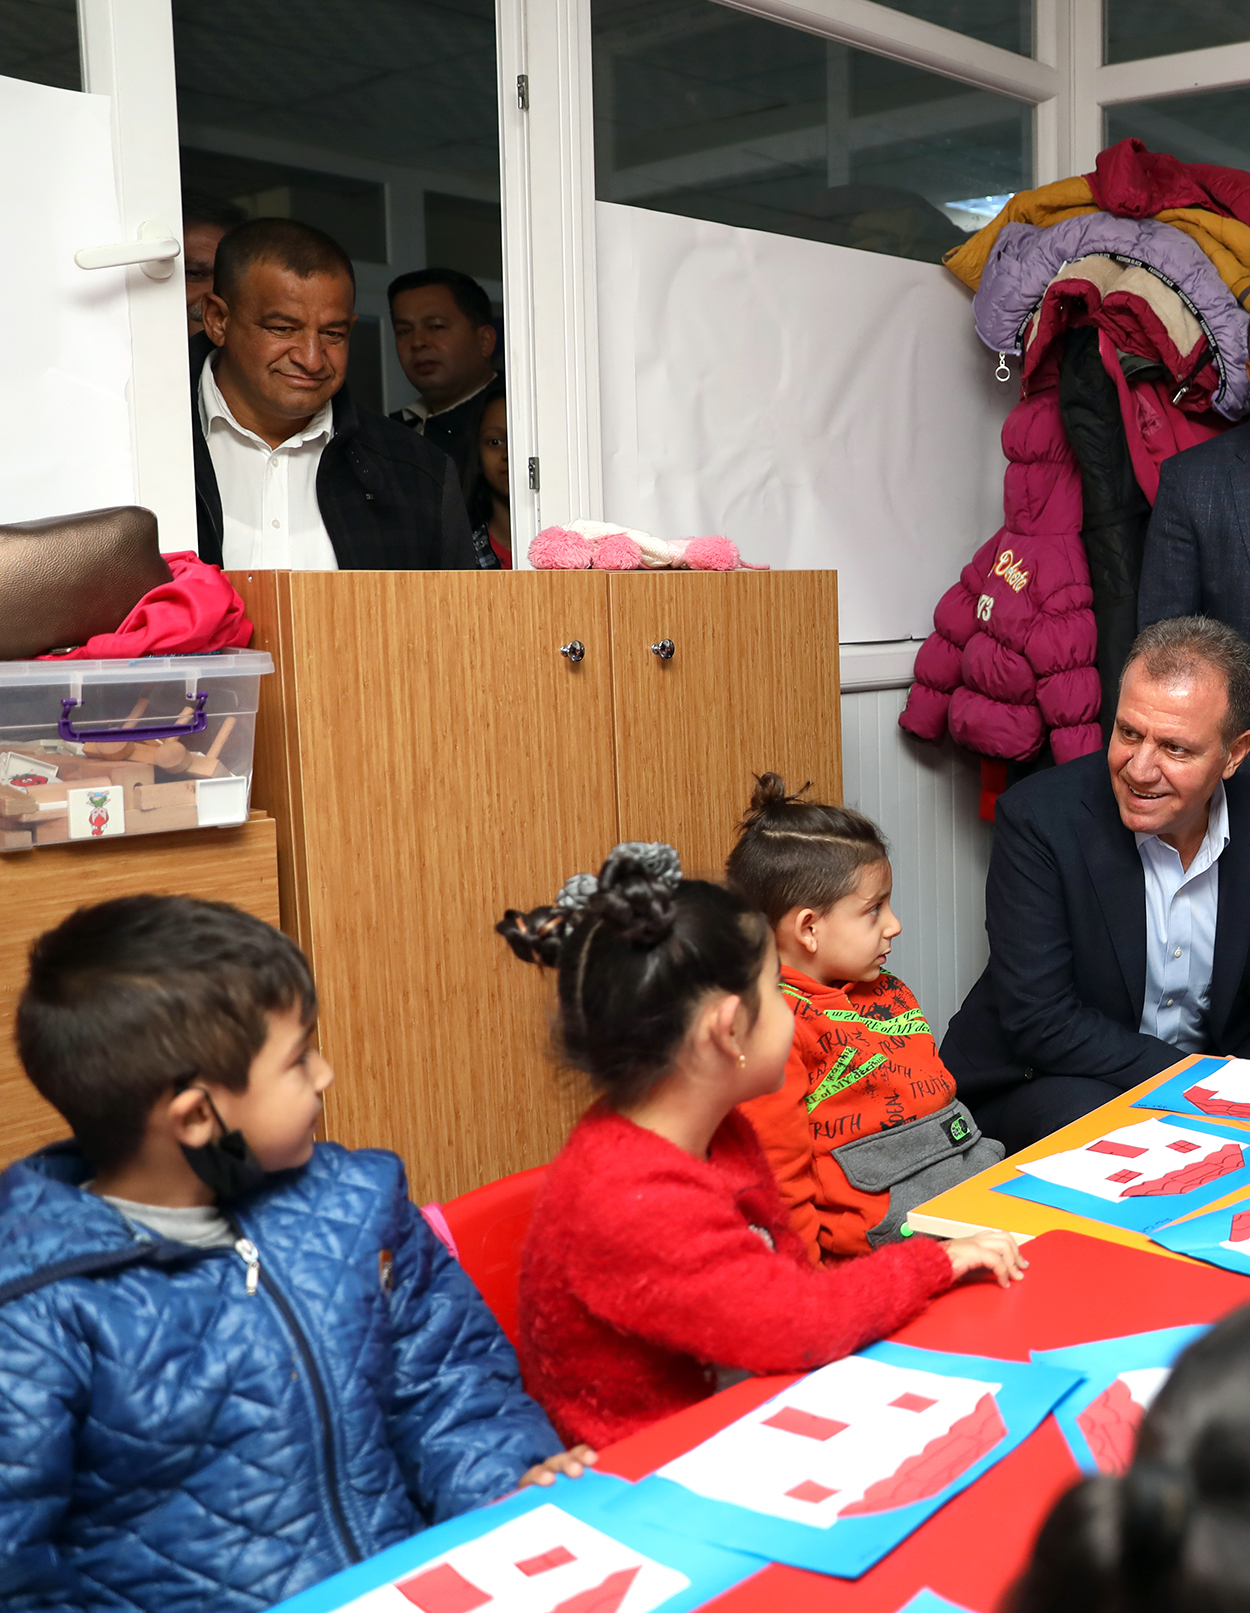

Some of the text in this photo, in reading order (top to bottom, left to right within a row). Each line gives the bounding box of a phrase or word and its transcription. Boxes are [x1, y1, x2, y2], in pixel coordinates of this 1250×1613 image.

[977, 594, 995, 622] 73
[893, 1022, 917, 1035] MY
[821, 1088, 832, 1098] of
[832, 1075, 853, 1092] MY
[909, 1077, 949, 1099] TRUTH
[809, 1113, 861, 1140] RUTH
